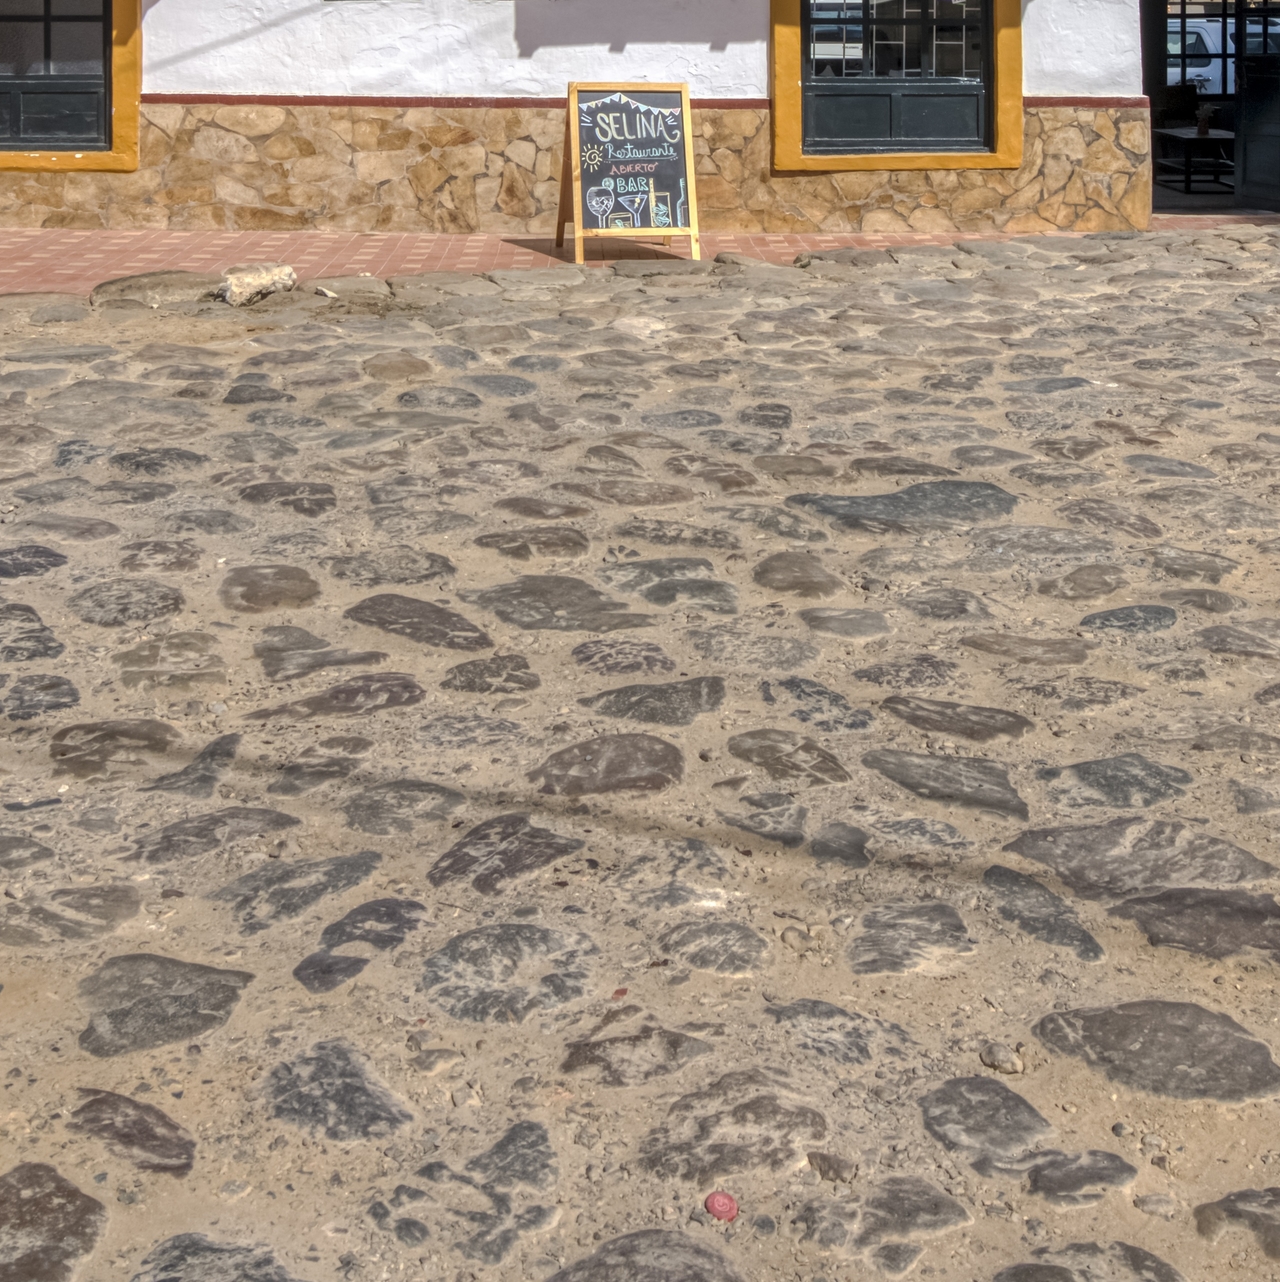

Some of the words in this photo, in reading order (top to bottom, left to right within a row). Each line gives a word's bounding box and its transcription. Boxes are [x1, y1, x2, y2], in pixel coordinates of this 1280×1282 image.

[595, 112, 681, 143] SELINA
[604, 142, 677, 160] Restaurante
[609, 161, 658, 176] ABIERTO
[617, 177, 649, 194] BAR
